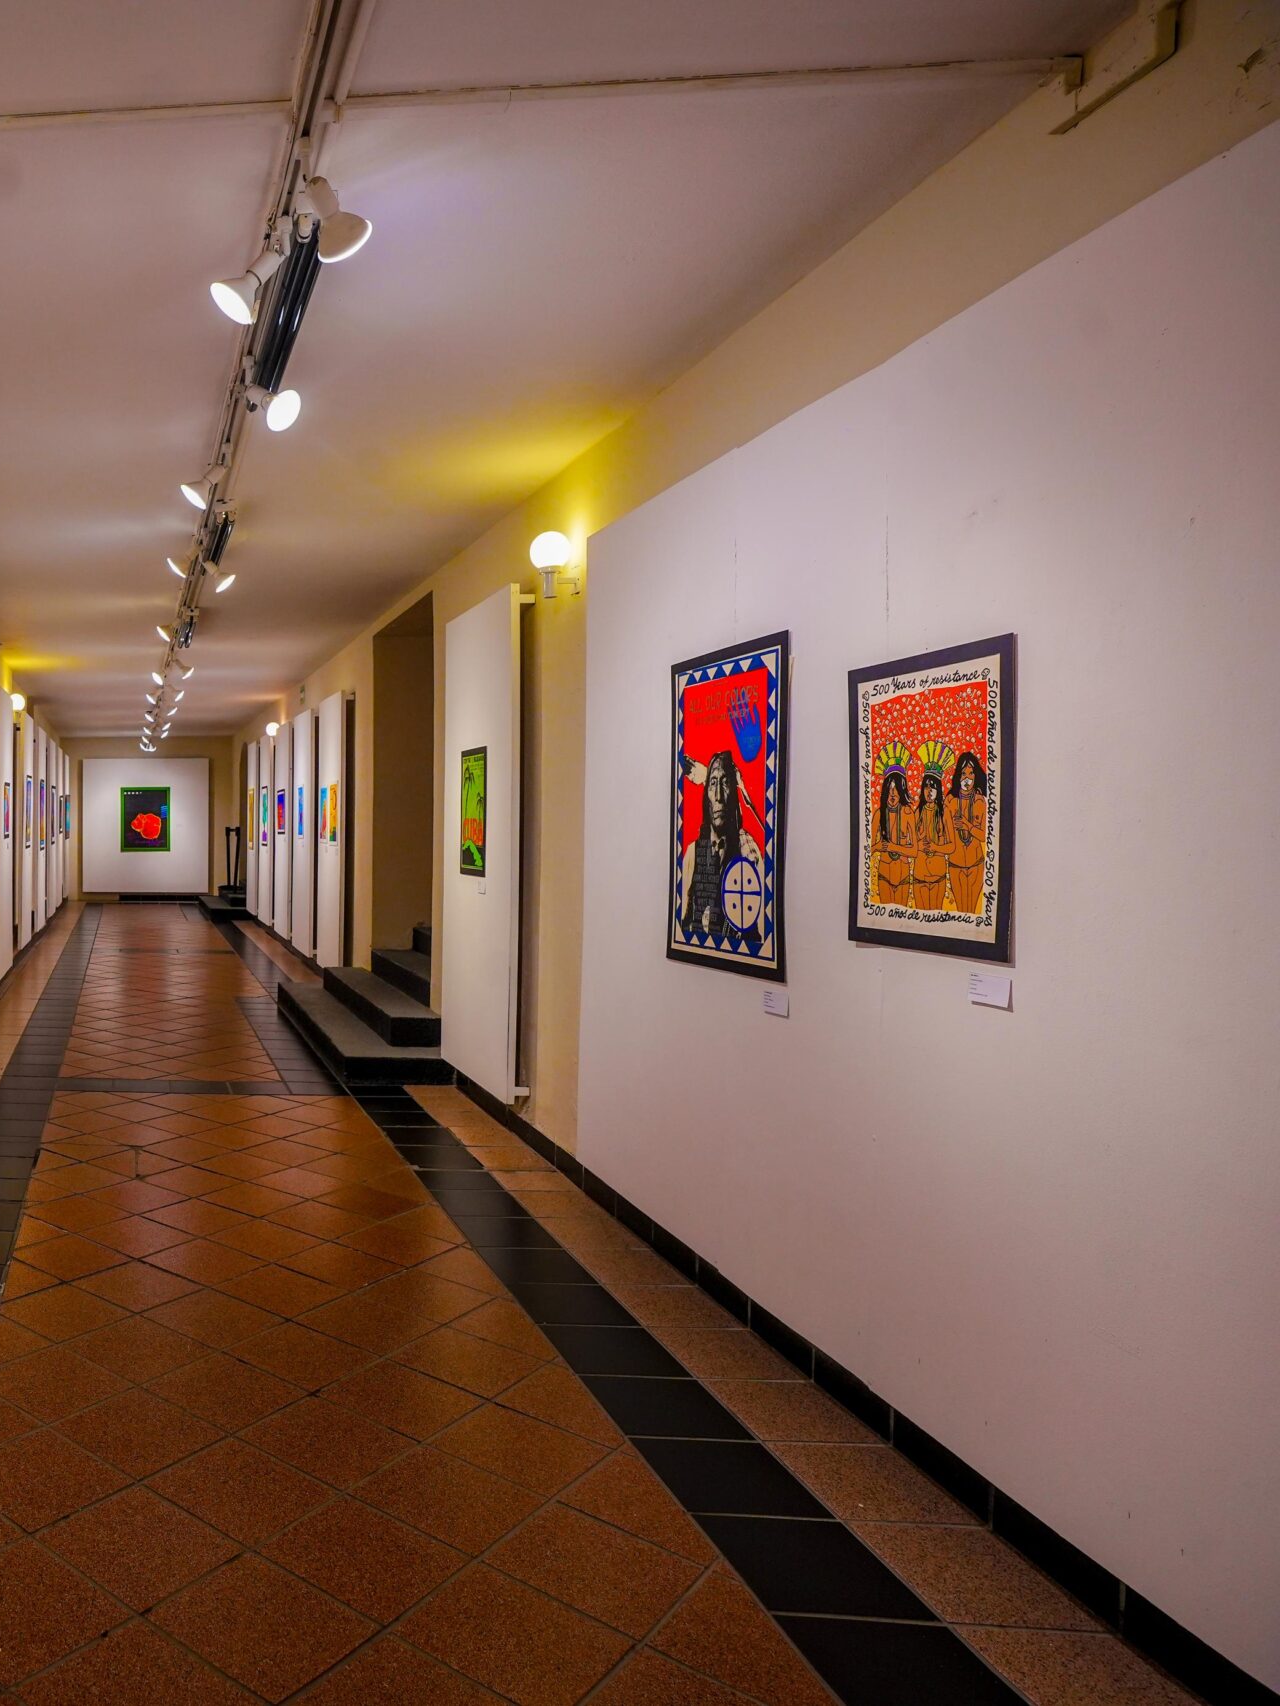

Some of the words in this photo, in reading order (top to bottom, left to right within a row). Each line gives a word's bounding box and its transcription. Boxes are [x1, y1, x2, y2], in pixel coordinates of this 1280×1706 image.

[871, 684, 889, 696] 500
[920, 678, 929, 688] of
[928, 670, 980, 688] resistance
[987, 678, 998, 708] 500
[862, 701, 870, 723] 500
[987, 710, 997, 743] años
[987, 745, 997, 765] de
[861, 762, 871, 775] of
[986, 765, 998, 849] resistencia
[463, 817, 484, 847] CUBA
[985, 860, 995, 887] 500
[867, 904, 886, 917] 500
[888, 908, 907, 919] años
[907, 908, 920, 920] de
[920, 911, 974, 924] resistencia
